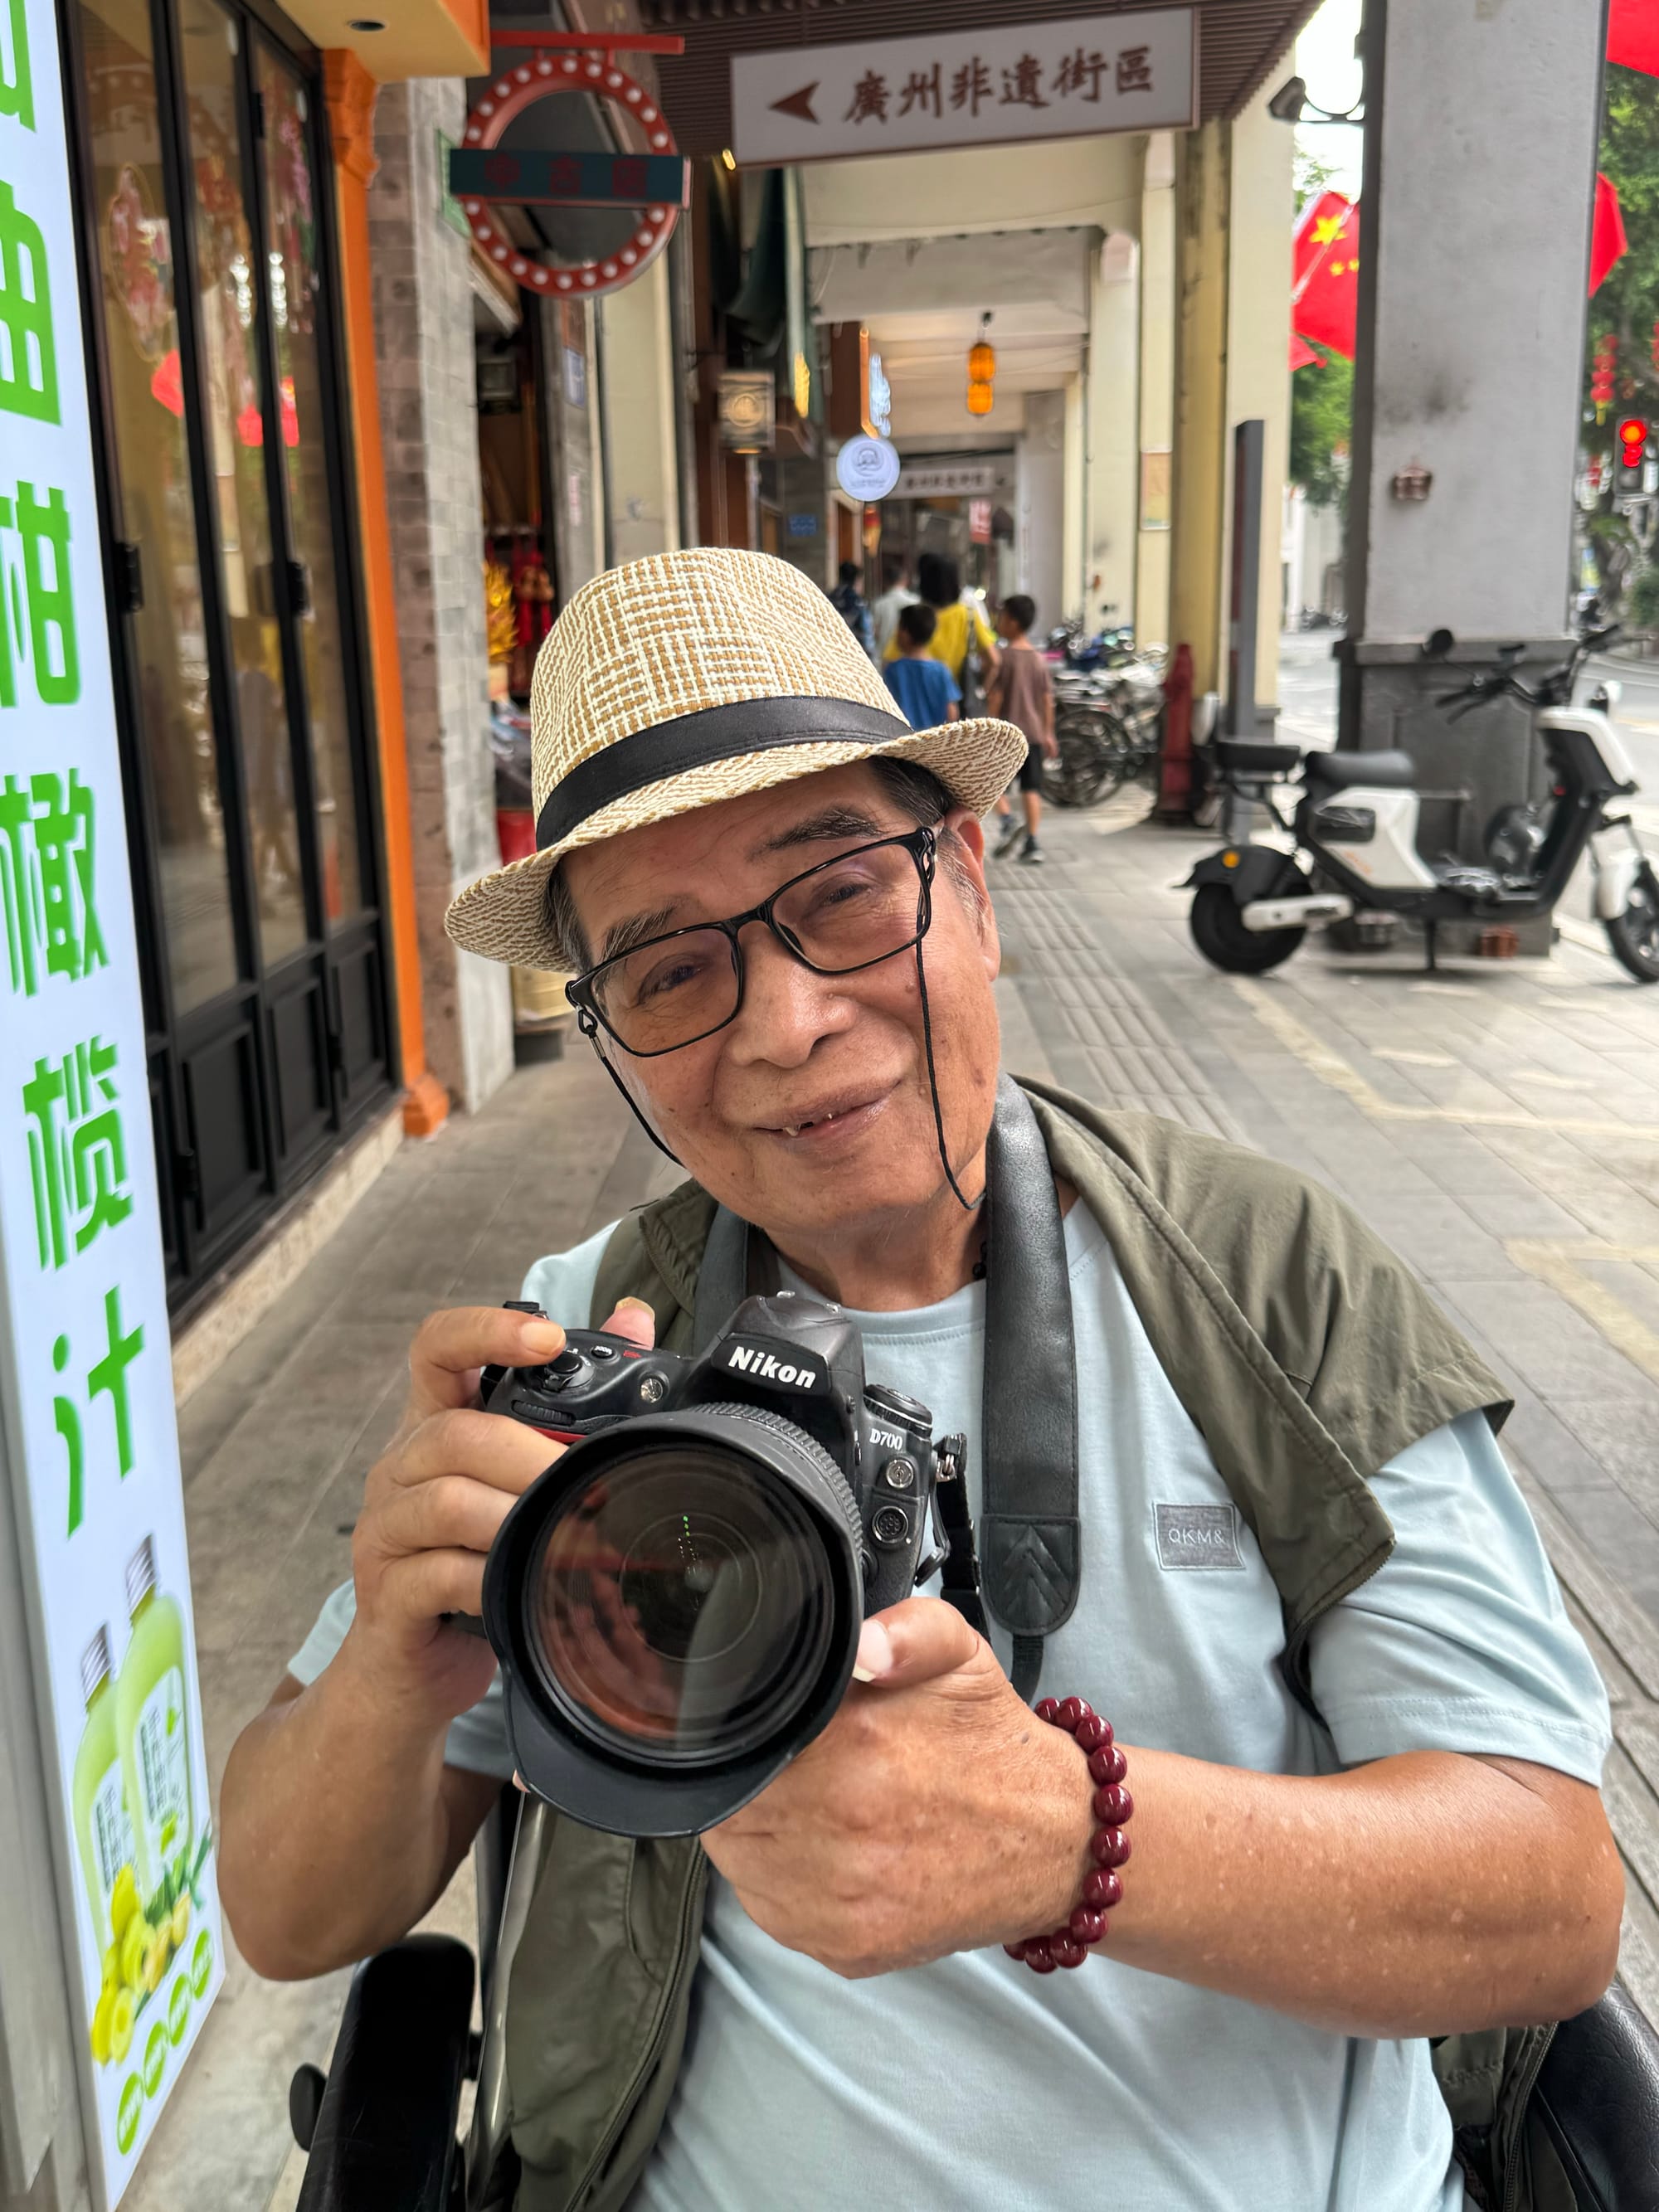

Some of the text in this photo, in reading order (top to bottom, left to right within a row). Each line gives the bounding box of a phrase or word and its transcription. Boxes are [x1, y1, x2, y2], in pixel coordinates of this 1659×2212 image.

[843, 45, 1154, 124] 廣州非遺街區
[0, 0, 144, 1540] 柑橄榄汁
[728, 1346, 816, 1388] Nikon
[869, 1427, 903, 1451] D700
